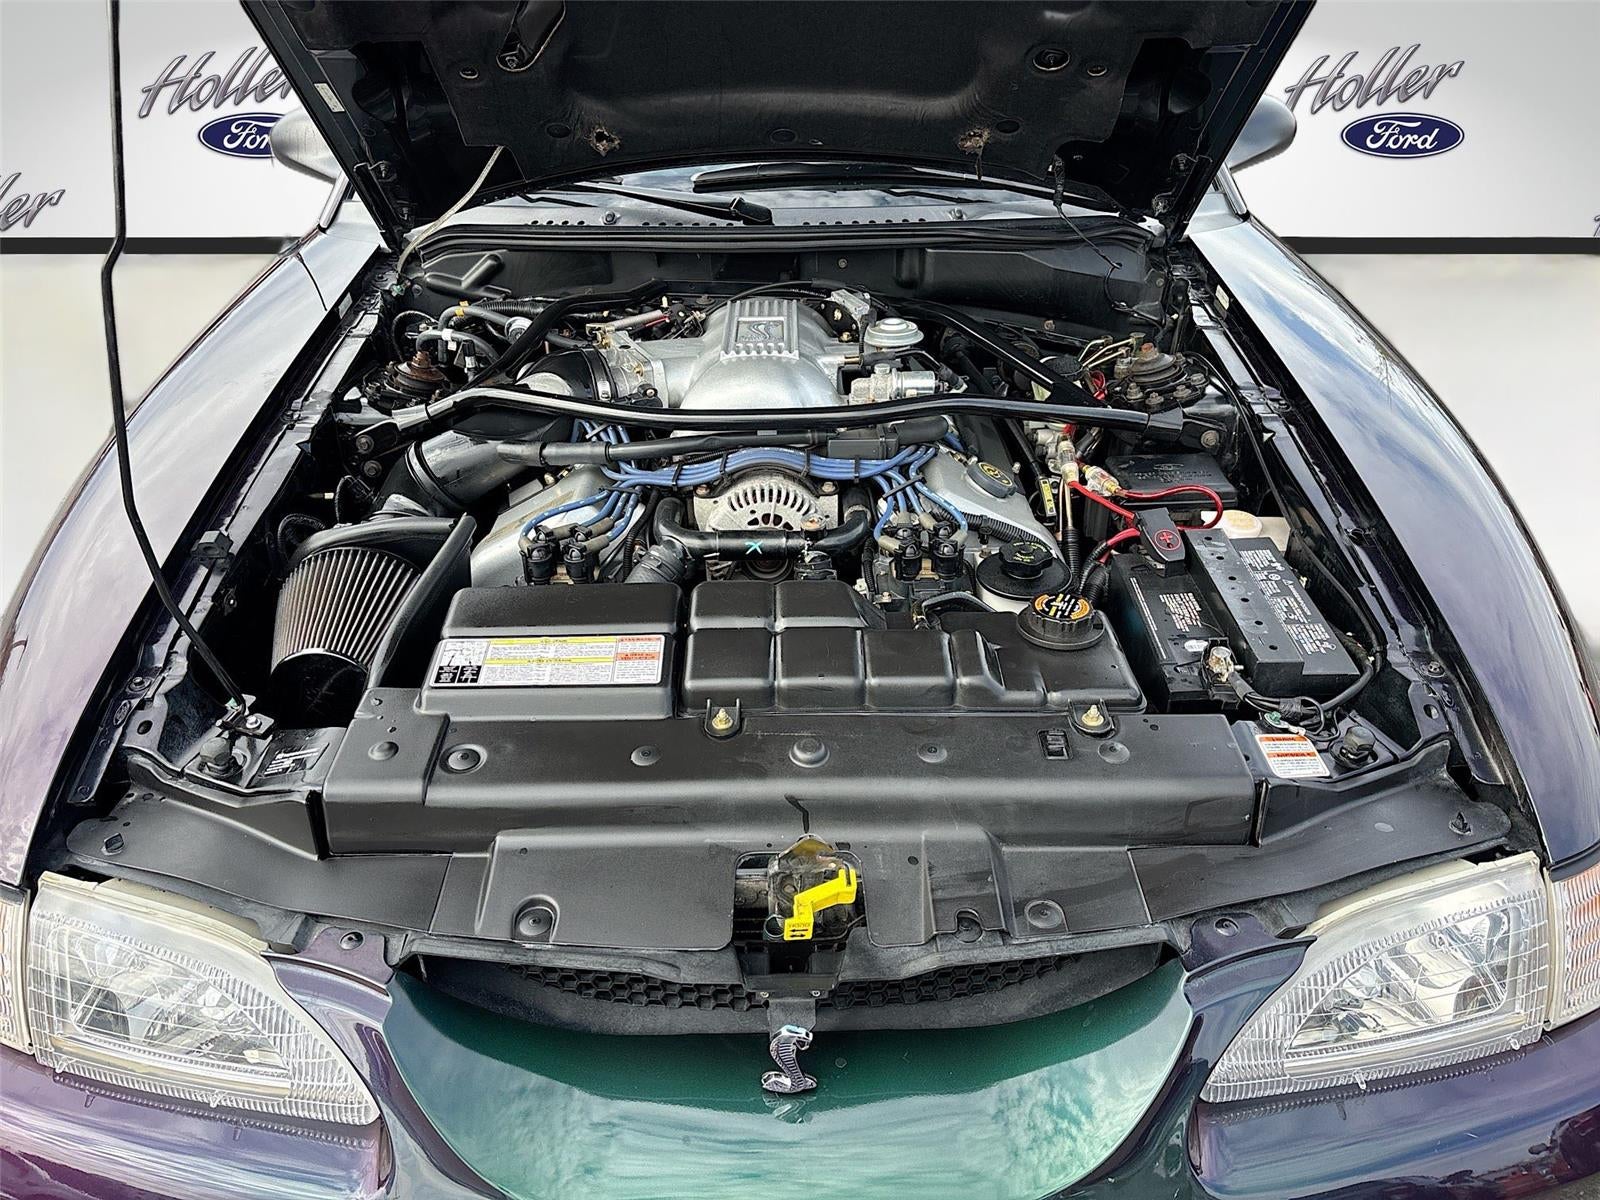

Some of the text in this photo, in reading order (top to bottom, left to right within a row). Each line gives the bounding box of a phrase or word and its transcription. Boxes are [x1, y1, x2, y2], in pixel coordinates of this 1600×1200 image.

[1284, 43, 1465, 115] Holler
[223, 119, 277, 149] For
[1366, 119, 1440, 150] Ford
